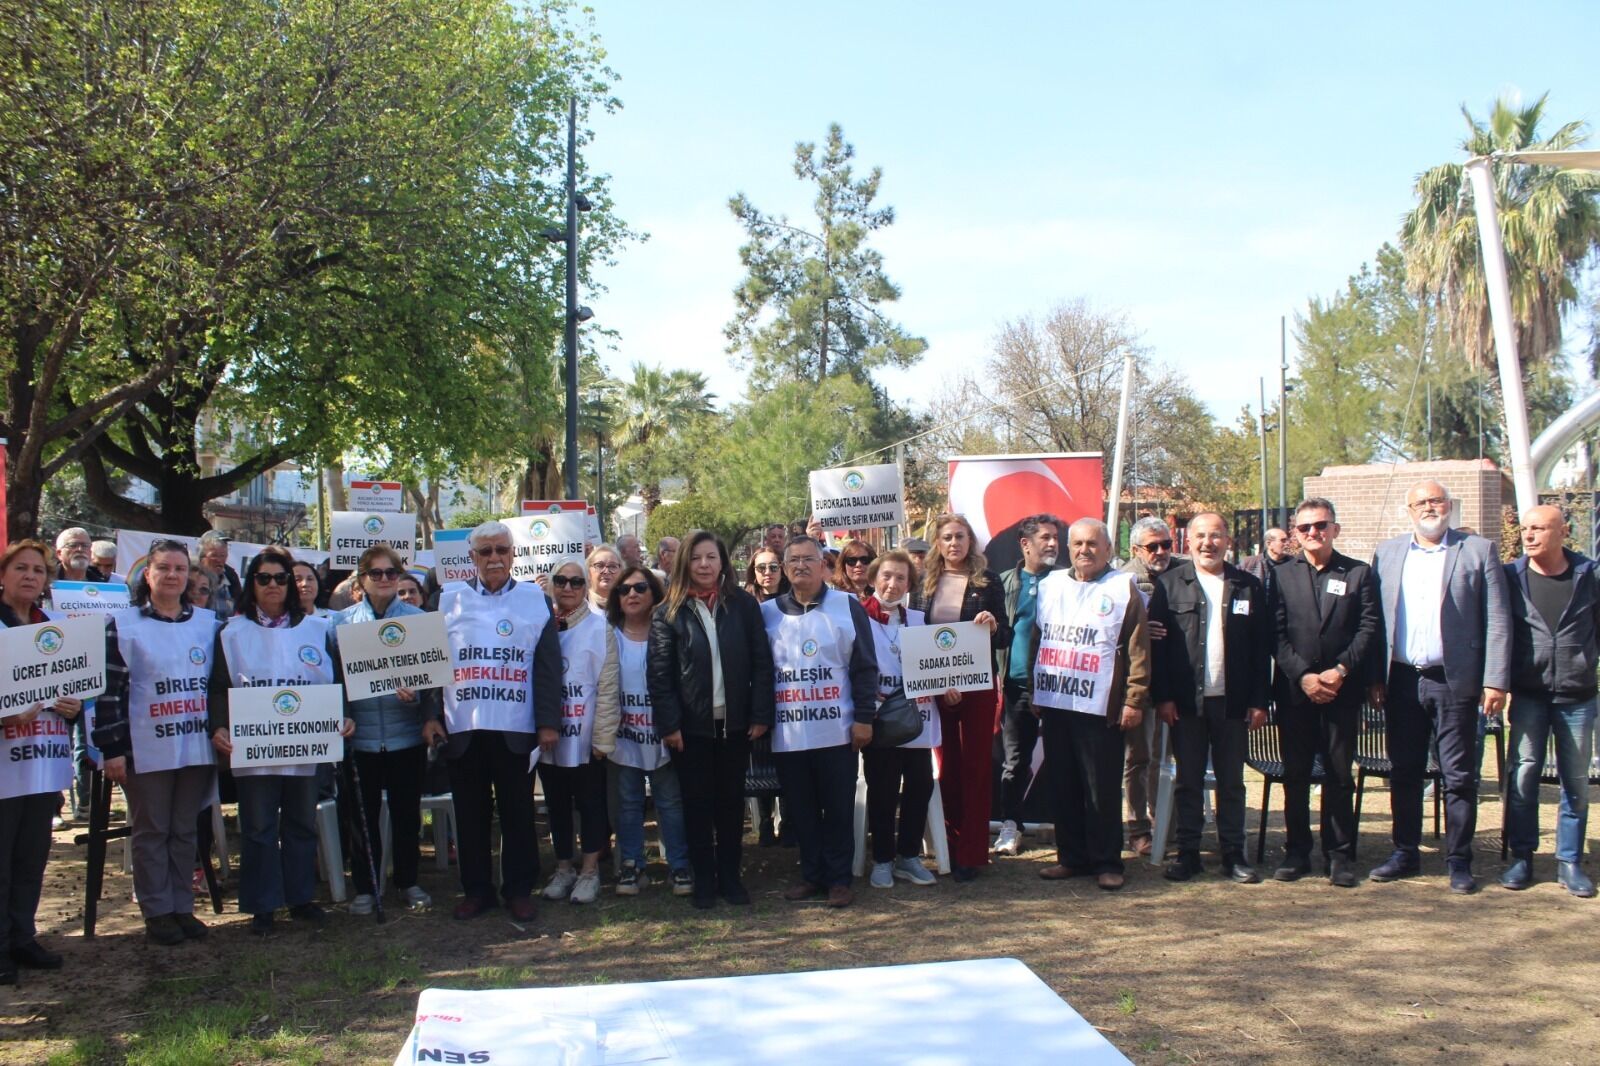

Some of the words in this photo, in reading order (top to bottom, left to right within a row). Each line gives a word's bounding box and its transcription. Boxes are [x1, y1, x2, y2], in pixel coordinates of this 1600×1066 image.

[815, 497, 851, 510] BÜROKRATA
[852, 496, 869, 507] BALLI
[871, 493, 897, 505] KAYMAK
[821, 514, 851, 527] EMEKLİYE
[852, 514, 869, 525] SIFIR
[869, 511, 894, 523] KAYNAK
[337, 538, 387, 550] ÇETELE
[390, 540, 409, 550] VAR
[513, 545, 530, 557] LÜM
[532, 543, 564, 557] MEŞRU
[567, 541, 582, 553] İSE
[336, 555, 360, 565] EME
[441, 554, 472, 567] GEÇİNE
[536, 562, 555, 574] HAK
[444, 567, 478, 579] İSYAN
[1043, 623, 1099, 646] BİRLEŞİK
[346, 657, 389, 675] KADINLAR
[390, 653, 419, 668] YEMEK
[420, 647, 448, 664] DEĞİL,
[459, 644, 525, 664] BİRLEŞİK
[919, 656, 951, 670] SADAKA
[952, 651, 974, 666] DEĞİL
[1038, 647, 1100, 673] EMEKLİLER
[13, 663, 48, 682] ÜCRET
[50, 652, 88, 675] ASGARİ
[453, 664, 528, 683] EMEKLİLER
[777, 664, 833, 684] BİRLEŞİK
[62, 671, 103, 696] SÜREKLİ
[155, 677, 208, 695] BİRLEŞ
[370, 675, 402, 693] DEVRİM
[403, 673, 432, 688] YAPAR.
[907, 677, 947, 692] HAKKIMIZI
[949, 672, 989, 687] İSTİYORUZ
[1037, 672, 1095, 699] SENDİKASI
[456, 684, 526, 704] SENDİKASI
[775, 685, 840, 704] EMEKLİLER
[150, 694, 207, 718] EMEKLİ
[777, 705, 841, 723] SENDİKASI
[155, 716, 209, 739] SENDİK
[234, 720, 285, 737] EMEKLİYE
[287, 717, 340, 735] EKONOMİK
[246, 743, 309, 760] BÜYÜMEDEN
[311, 743, 329, 756] PAY
